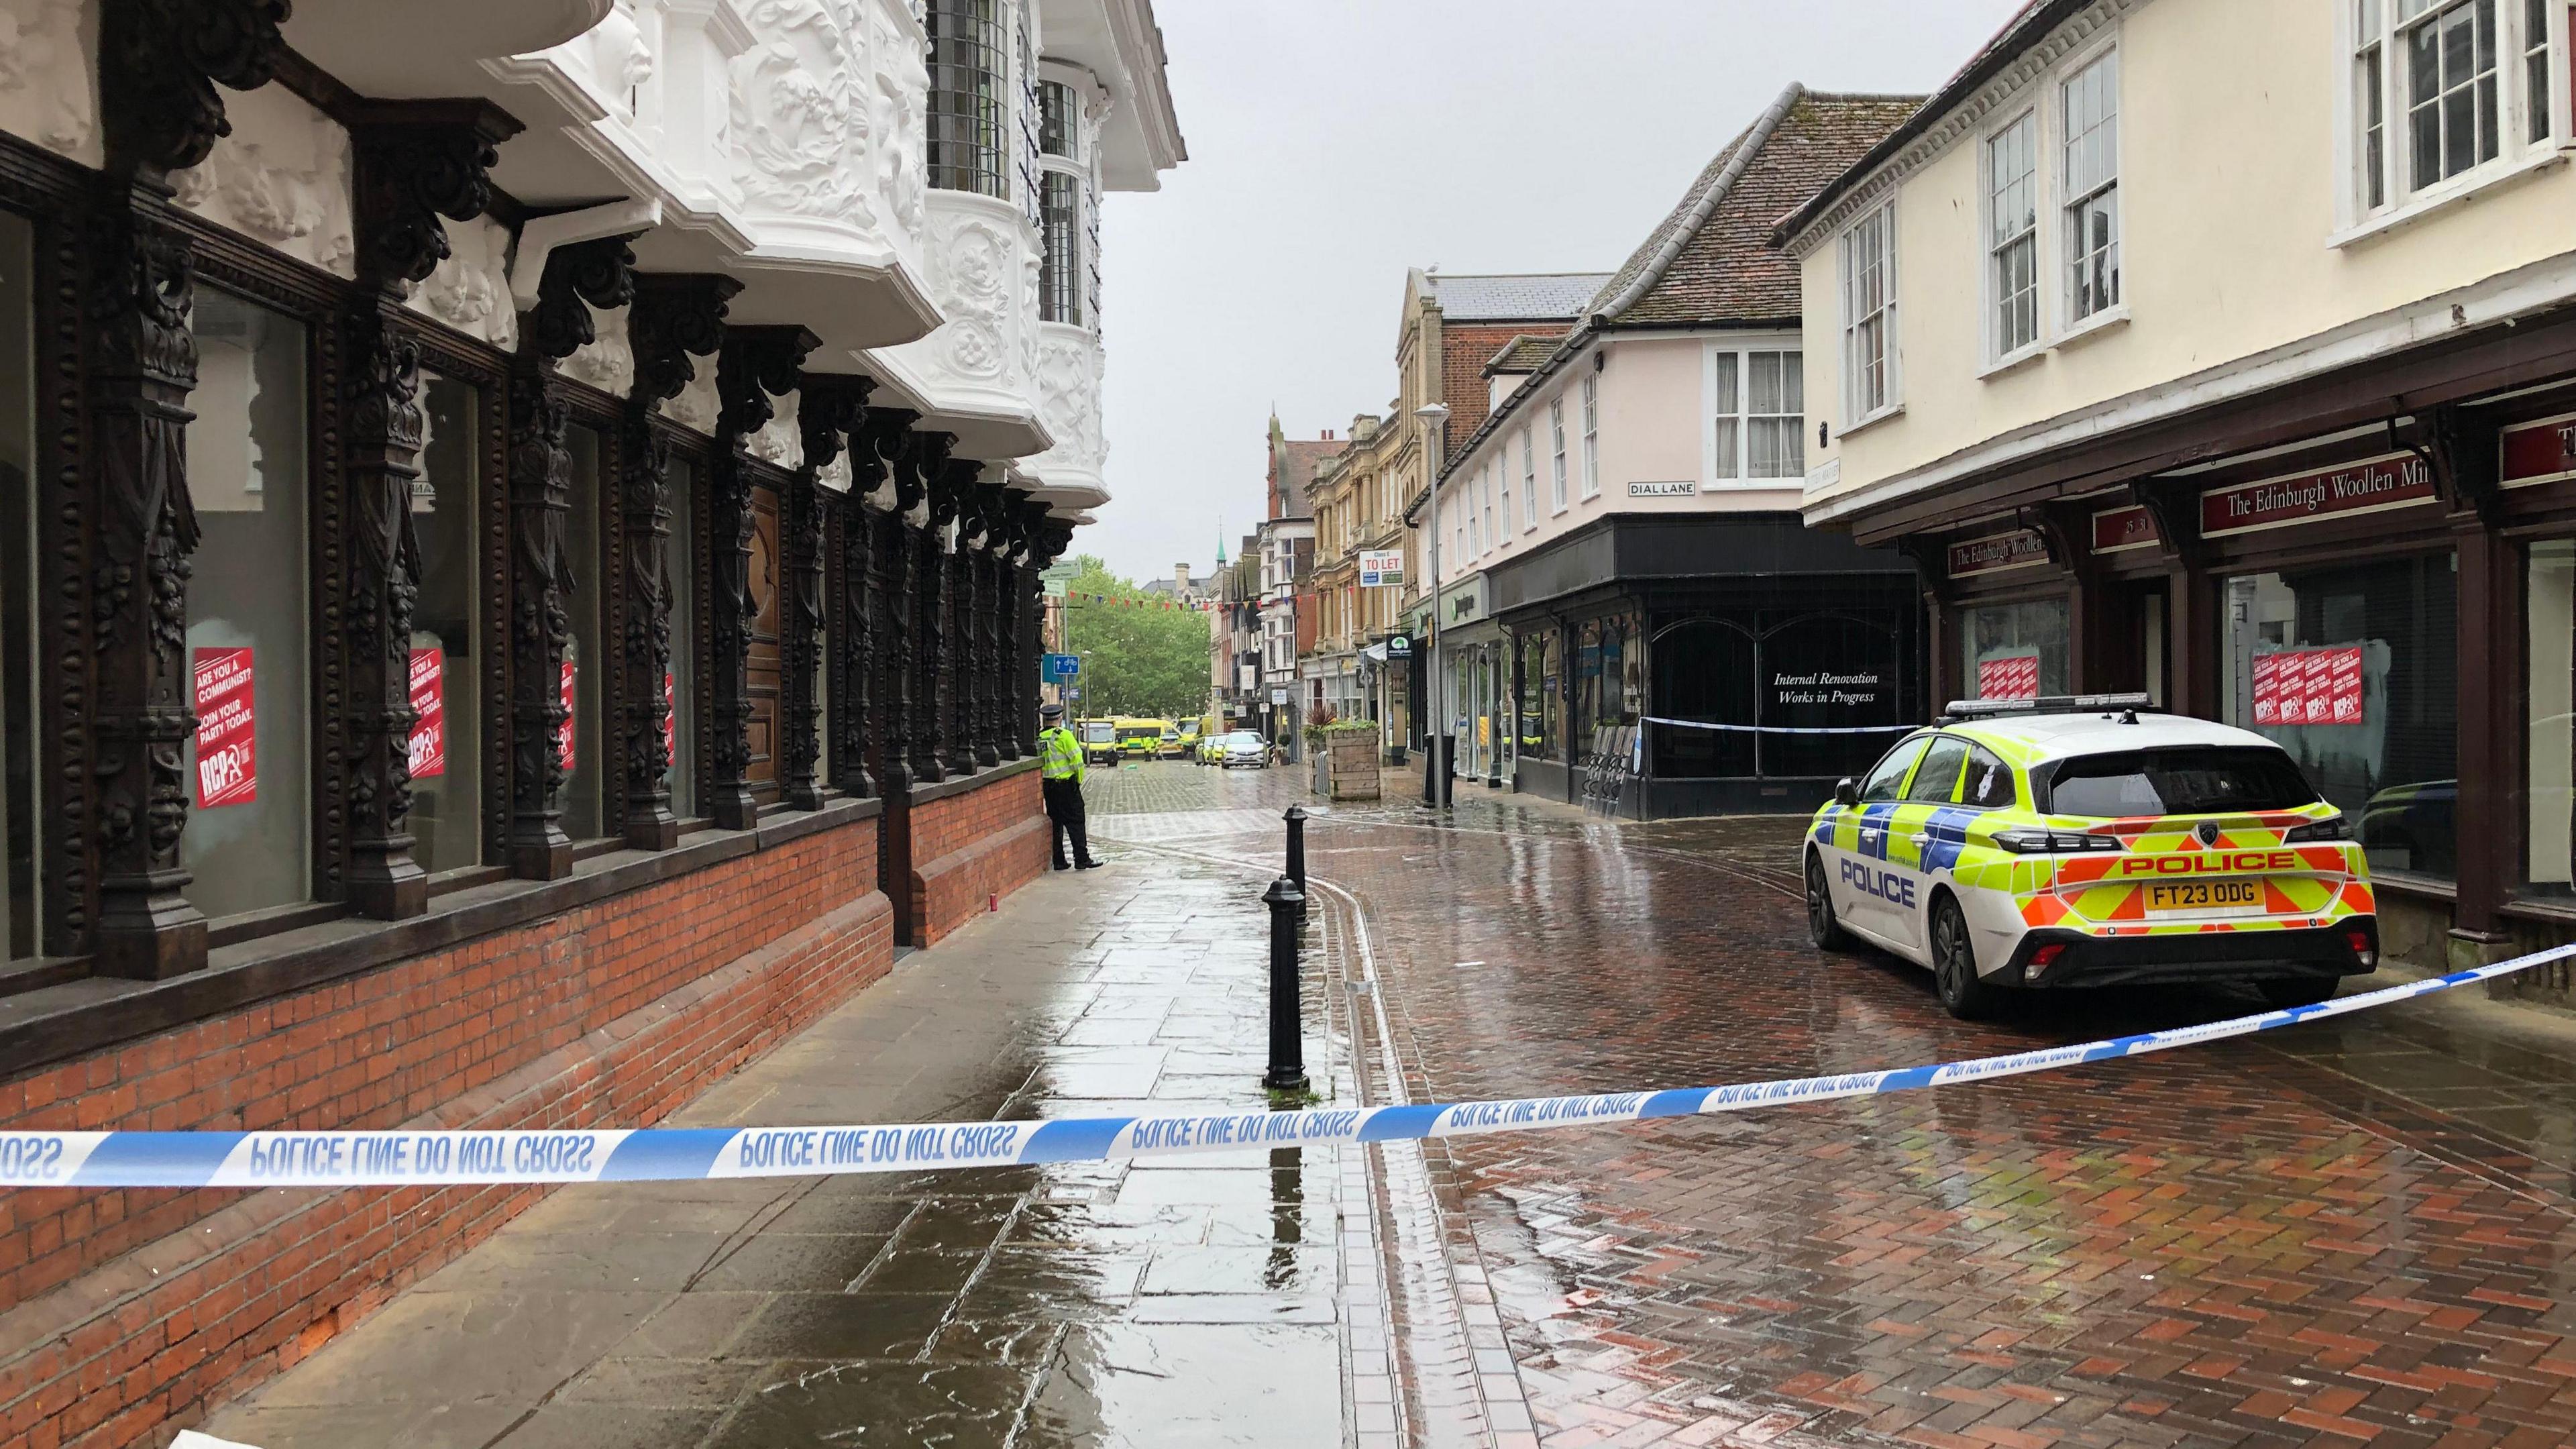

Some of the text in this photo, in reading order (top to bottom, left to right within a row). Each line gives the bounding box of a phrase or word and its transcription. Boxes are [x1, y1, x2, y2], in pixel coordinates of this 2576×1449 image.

[1631, 484, 1693, 494] DIAL LANE
[2227, 459, 2429, 517] The Edinburgh Woollen Mil
[1365, 558, 1400, 570] TO LET
[1957, 535, 2043, 566] The Edinburgh Woollen
[197, 659, 239, 689] ARE YOU A
[199, 667, 252, 704] COMMUNIST?
[410, 664, 441, 692] OMMUNIST?
[1774, 672, 1878, 685] Internal Renovation
[1780, 690, 1875, 705] Works in Progress
[199, 698, 241, 730] JOIN YOUR
[200, 708, 252, 745] PARTY TODAY.
[200, 750, 229, 797] RCP
[2123, 852, 2295, 875] POLICE
[1841, 857, 1916, 910] POLICE
[2153, 882, 2255, 905] FT23 ODG
